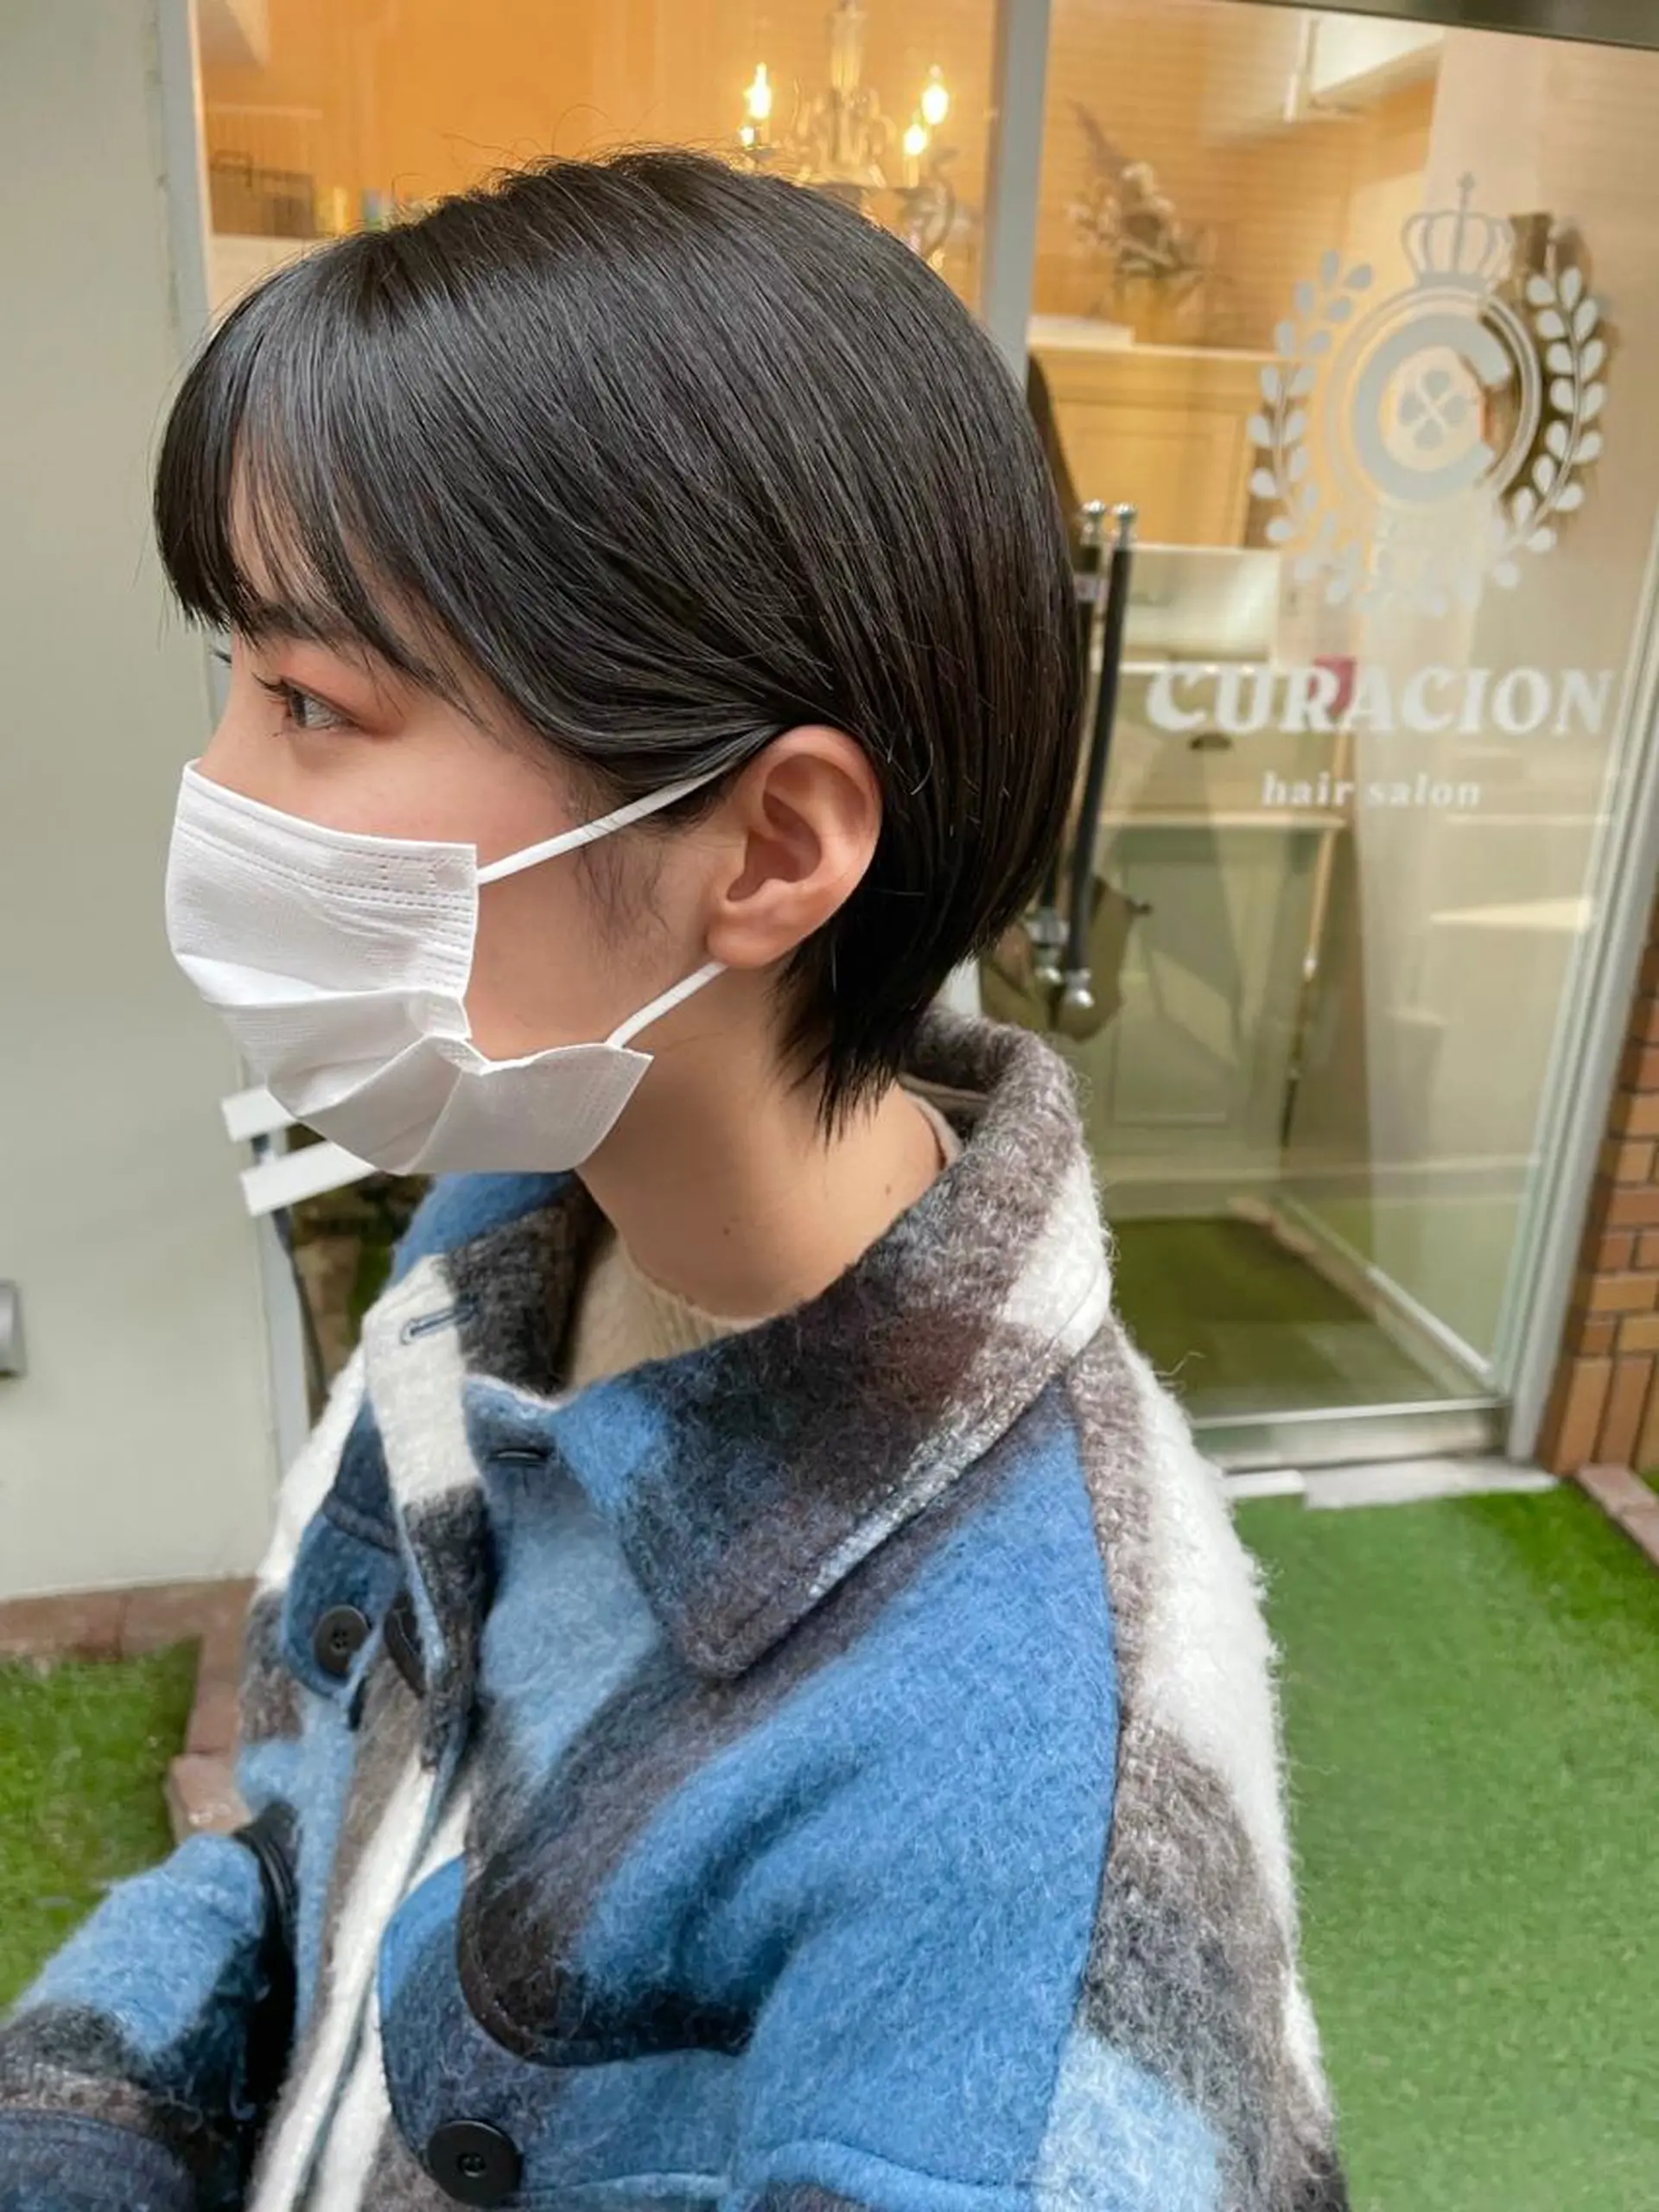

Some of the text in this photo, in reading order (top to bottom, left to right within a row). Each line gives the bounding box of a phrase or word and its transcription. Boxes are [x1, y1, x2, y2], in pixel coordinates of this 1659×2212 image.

[1145, 662, 1612, 735] CURACION
[1262, 771, 1481, 808] hair salon
